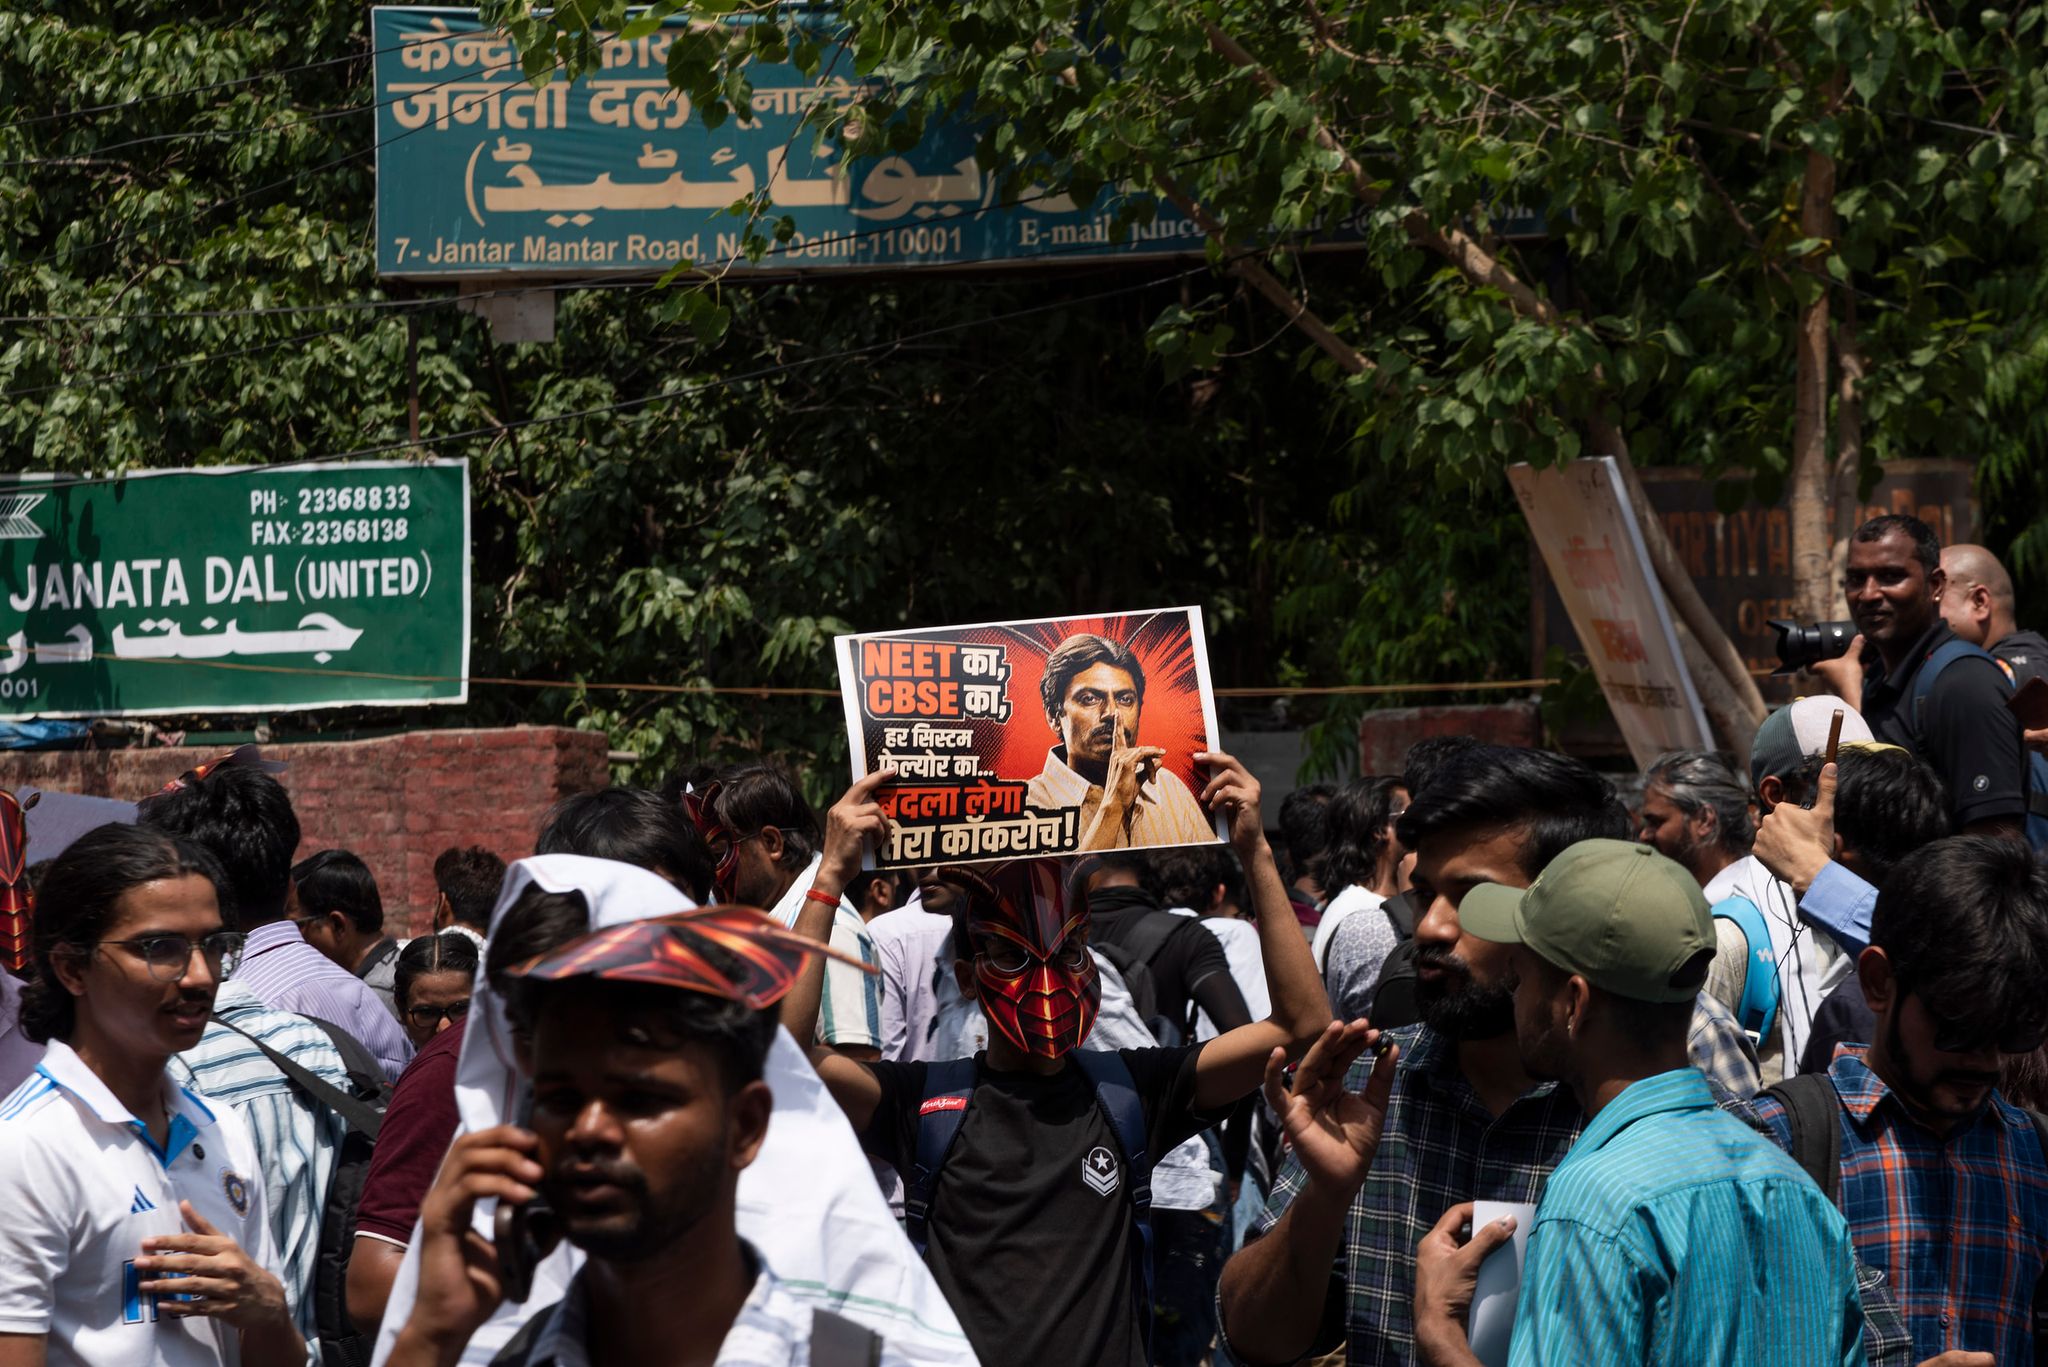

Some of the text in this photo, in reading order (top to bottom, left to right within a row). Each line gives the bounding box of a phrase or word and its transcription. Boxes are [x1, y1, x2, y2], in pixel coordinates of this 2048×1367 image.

[386, 82, 571, 131] जनता
[586, 79, 691, 131] दल
[427, 237, 516, 264] Jantar
[523, 235, 618, 262] Mantar
[627, 233, 706, 264] Road,
[298, 484, 411, 514] 23368833
[9, 549, 432, 612] JANATA DAL (UNITED)
[864, 642, 1006, 681] NEET का,
[868, 680, 1007, 719] CBSE का,
[884, 723, 974, 749] हर सिस्टम
[964, 779, 1025, 815] लेगा
